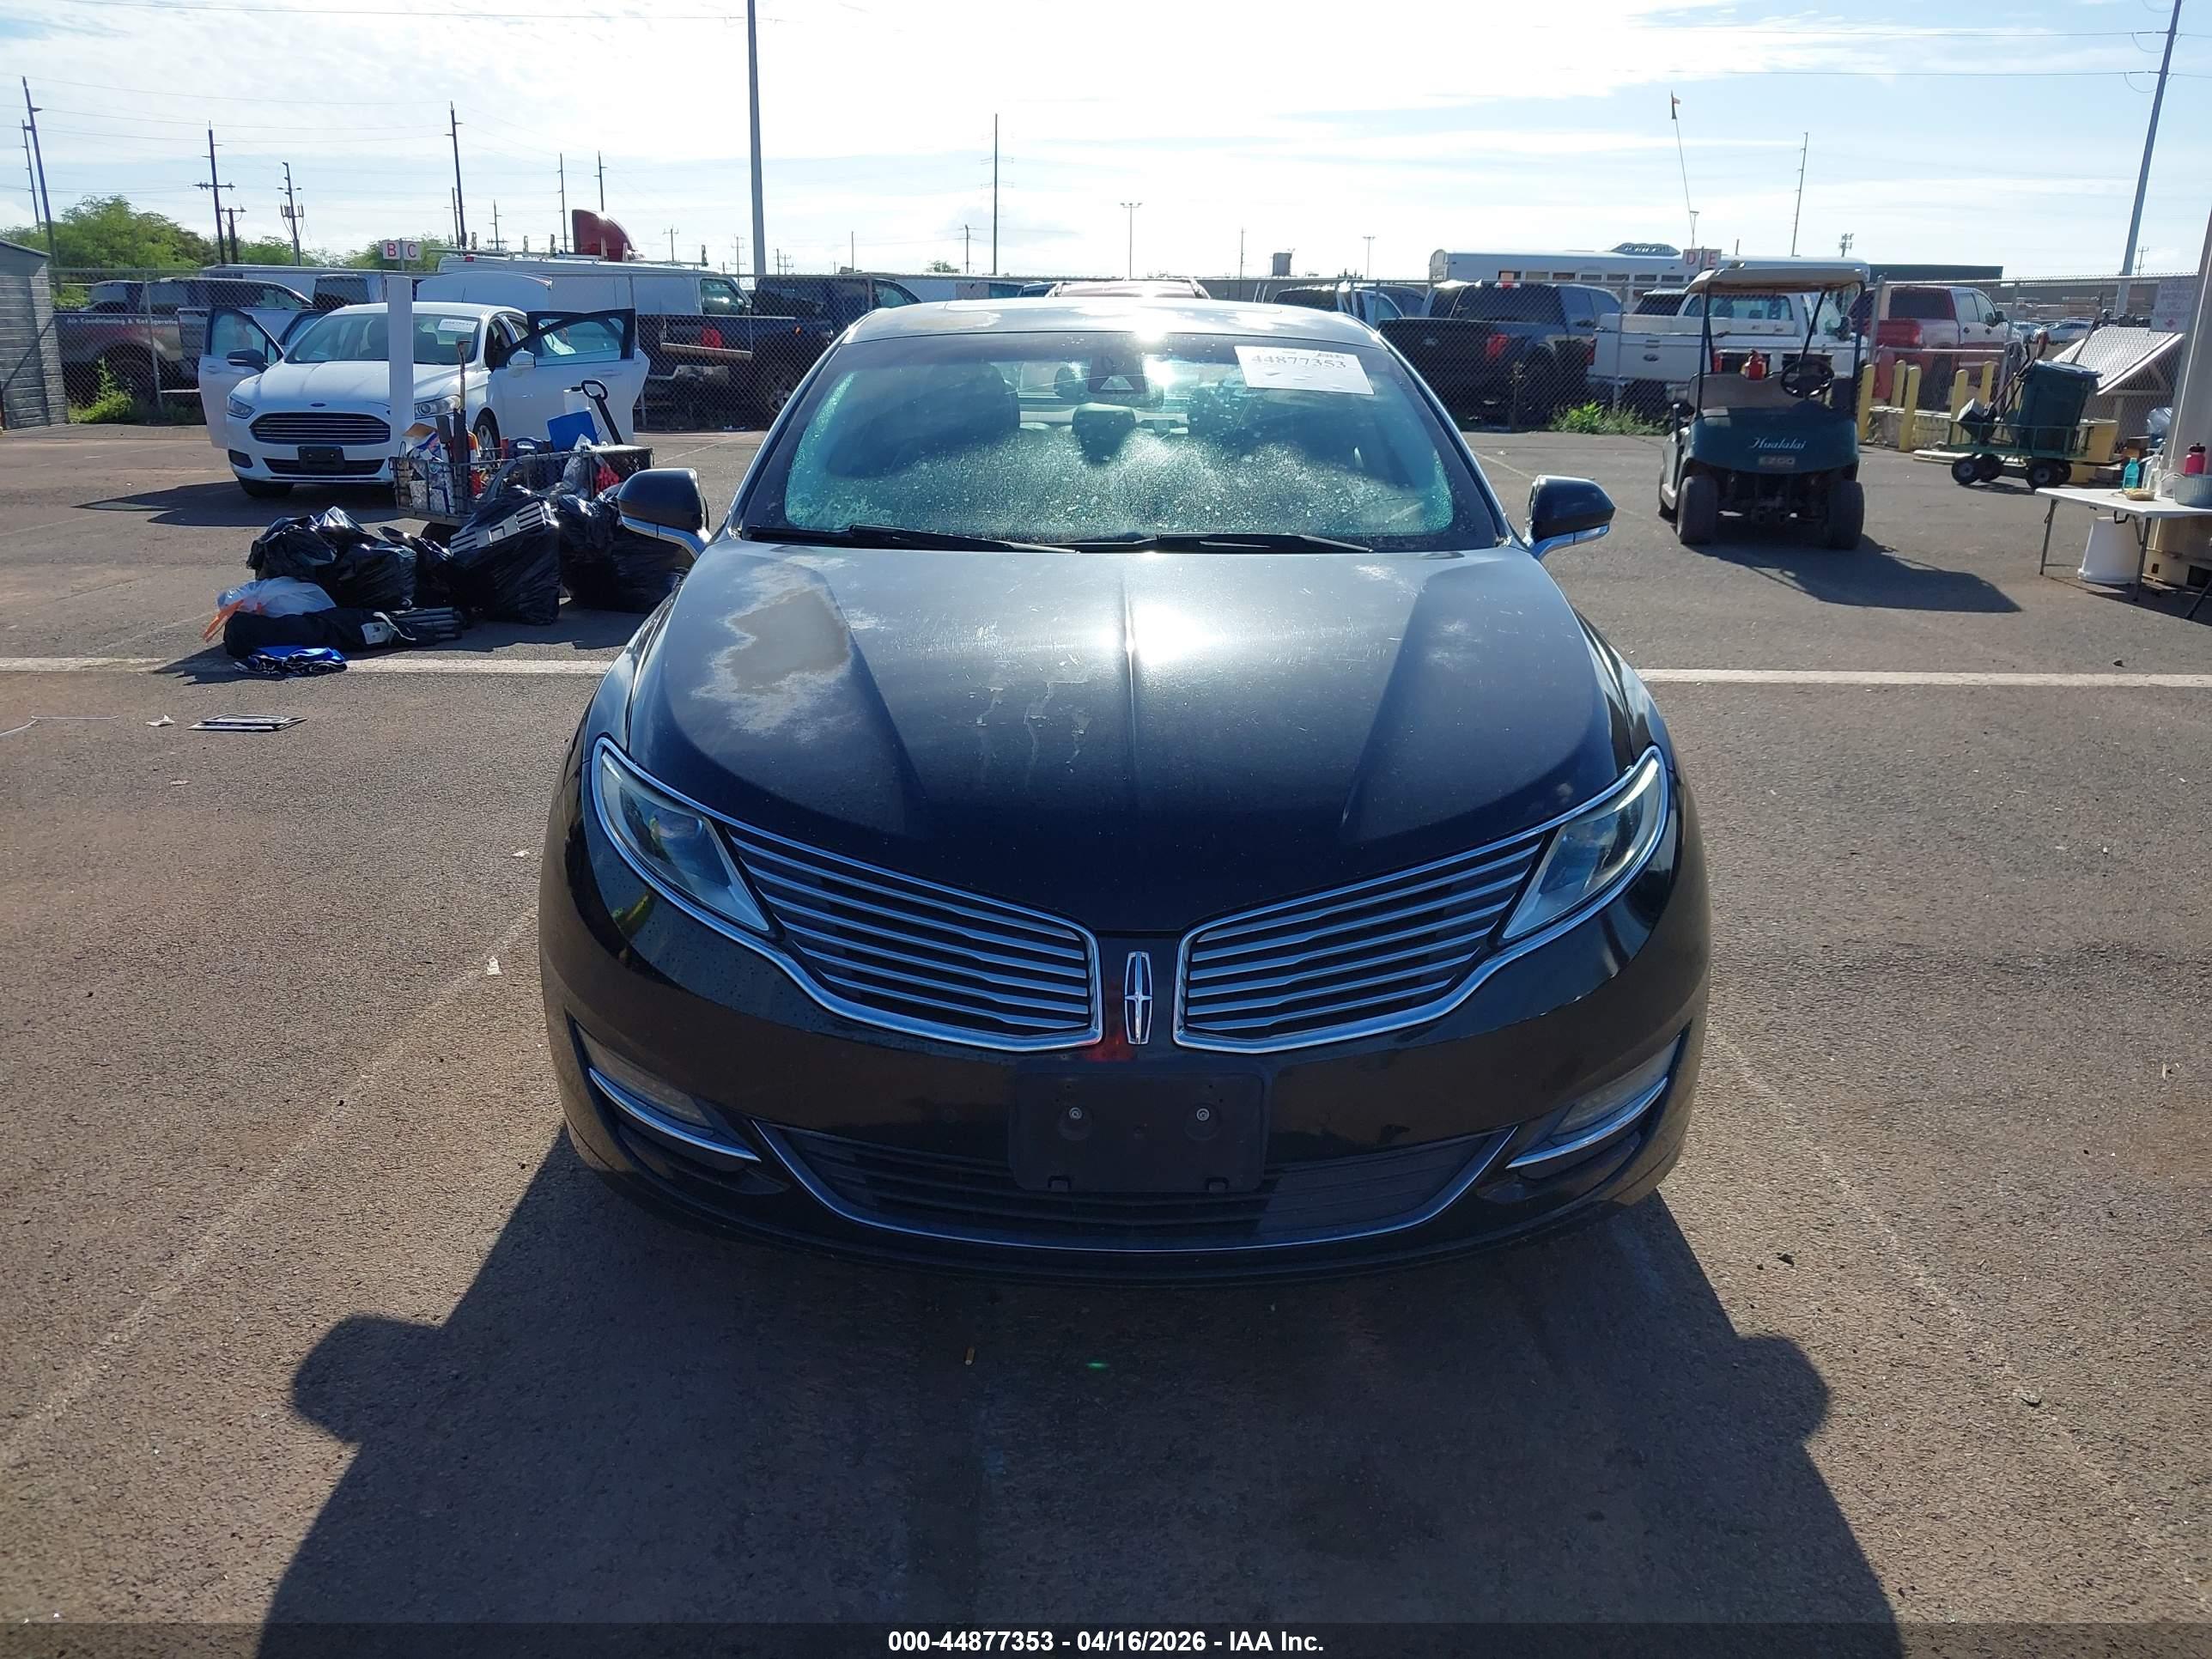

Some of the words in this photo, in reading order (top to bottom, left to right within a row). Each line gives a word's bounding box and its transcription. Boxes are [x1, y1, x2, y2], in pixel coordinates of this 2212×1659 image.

[387, 243, 397, 257] B
[407, 244, 416, 258] C
[1686, 252, 1696, 265] D
[1708, 251, 1717, 265] E
[81, 317, 125, 325] Conditioning
[1252, 355, 1346, 368] 44877353
